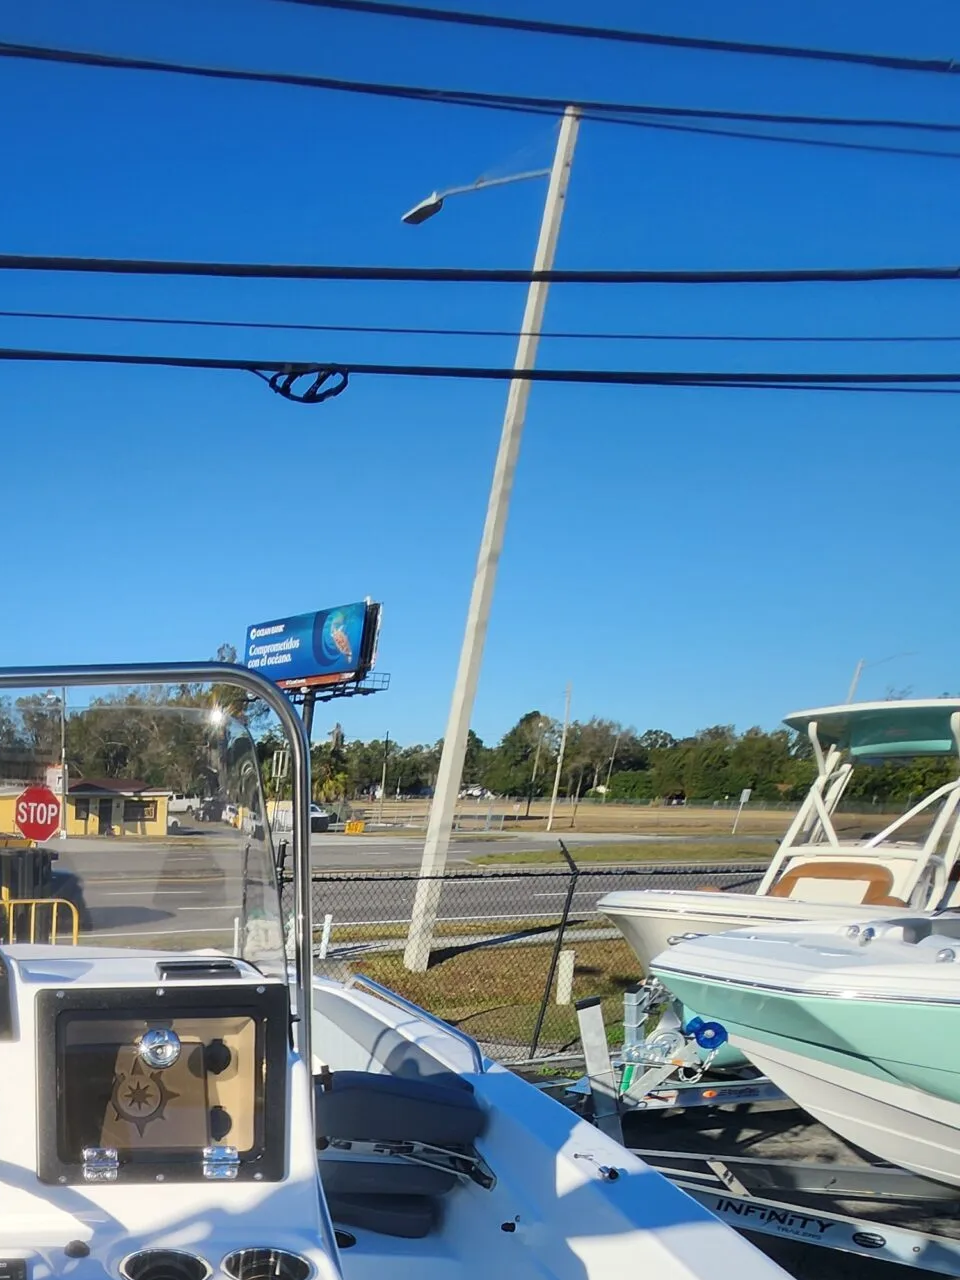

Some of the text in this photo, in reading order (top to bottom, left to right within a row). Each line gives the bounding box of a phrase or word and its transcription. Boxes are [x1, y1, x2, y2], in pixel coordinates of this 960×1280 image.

[249, 637, 300, 656] Comprometidos
[247, 658, 259, 669] con
[260, 655, 267, 667] el
[17, 801, 58, 825] STOP
[776, 1226, 823, 1241] TRAILERS
